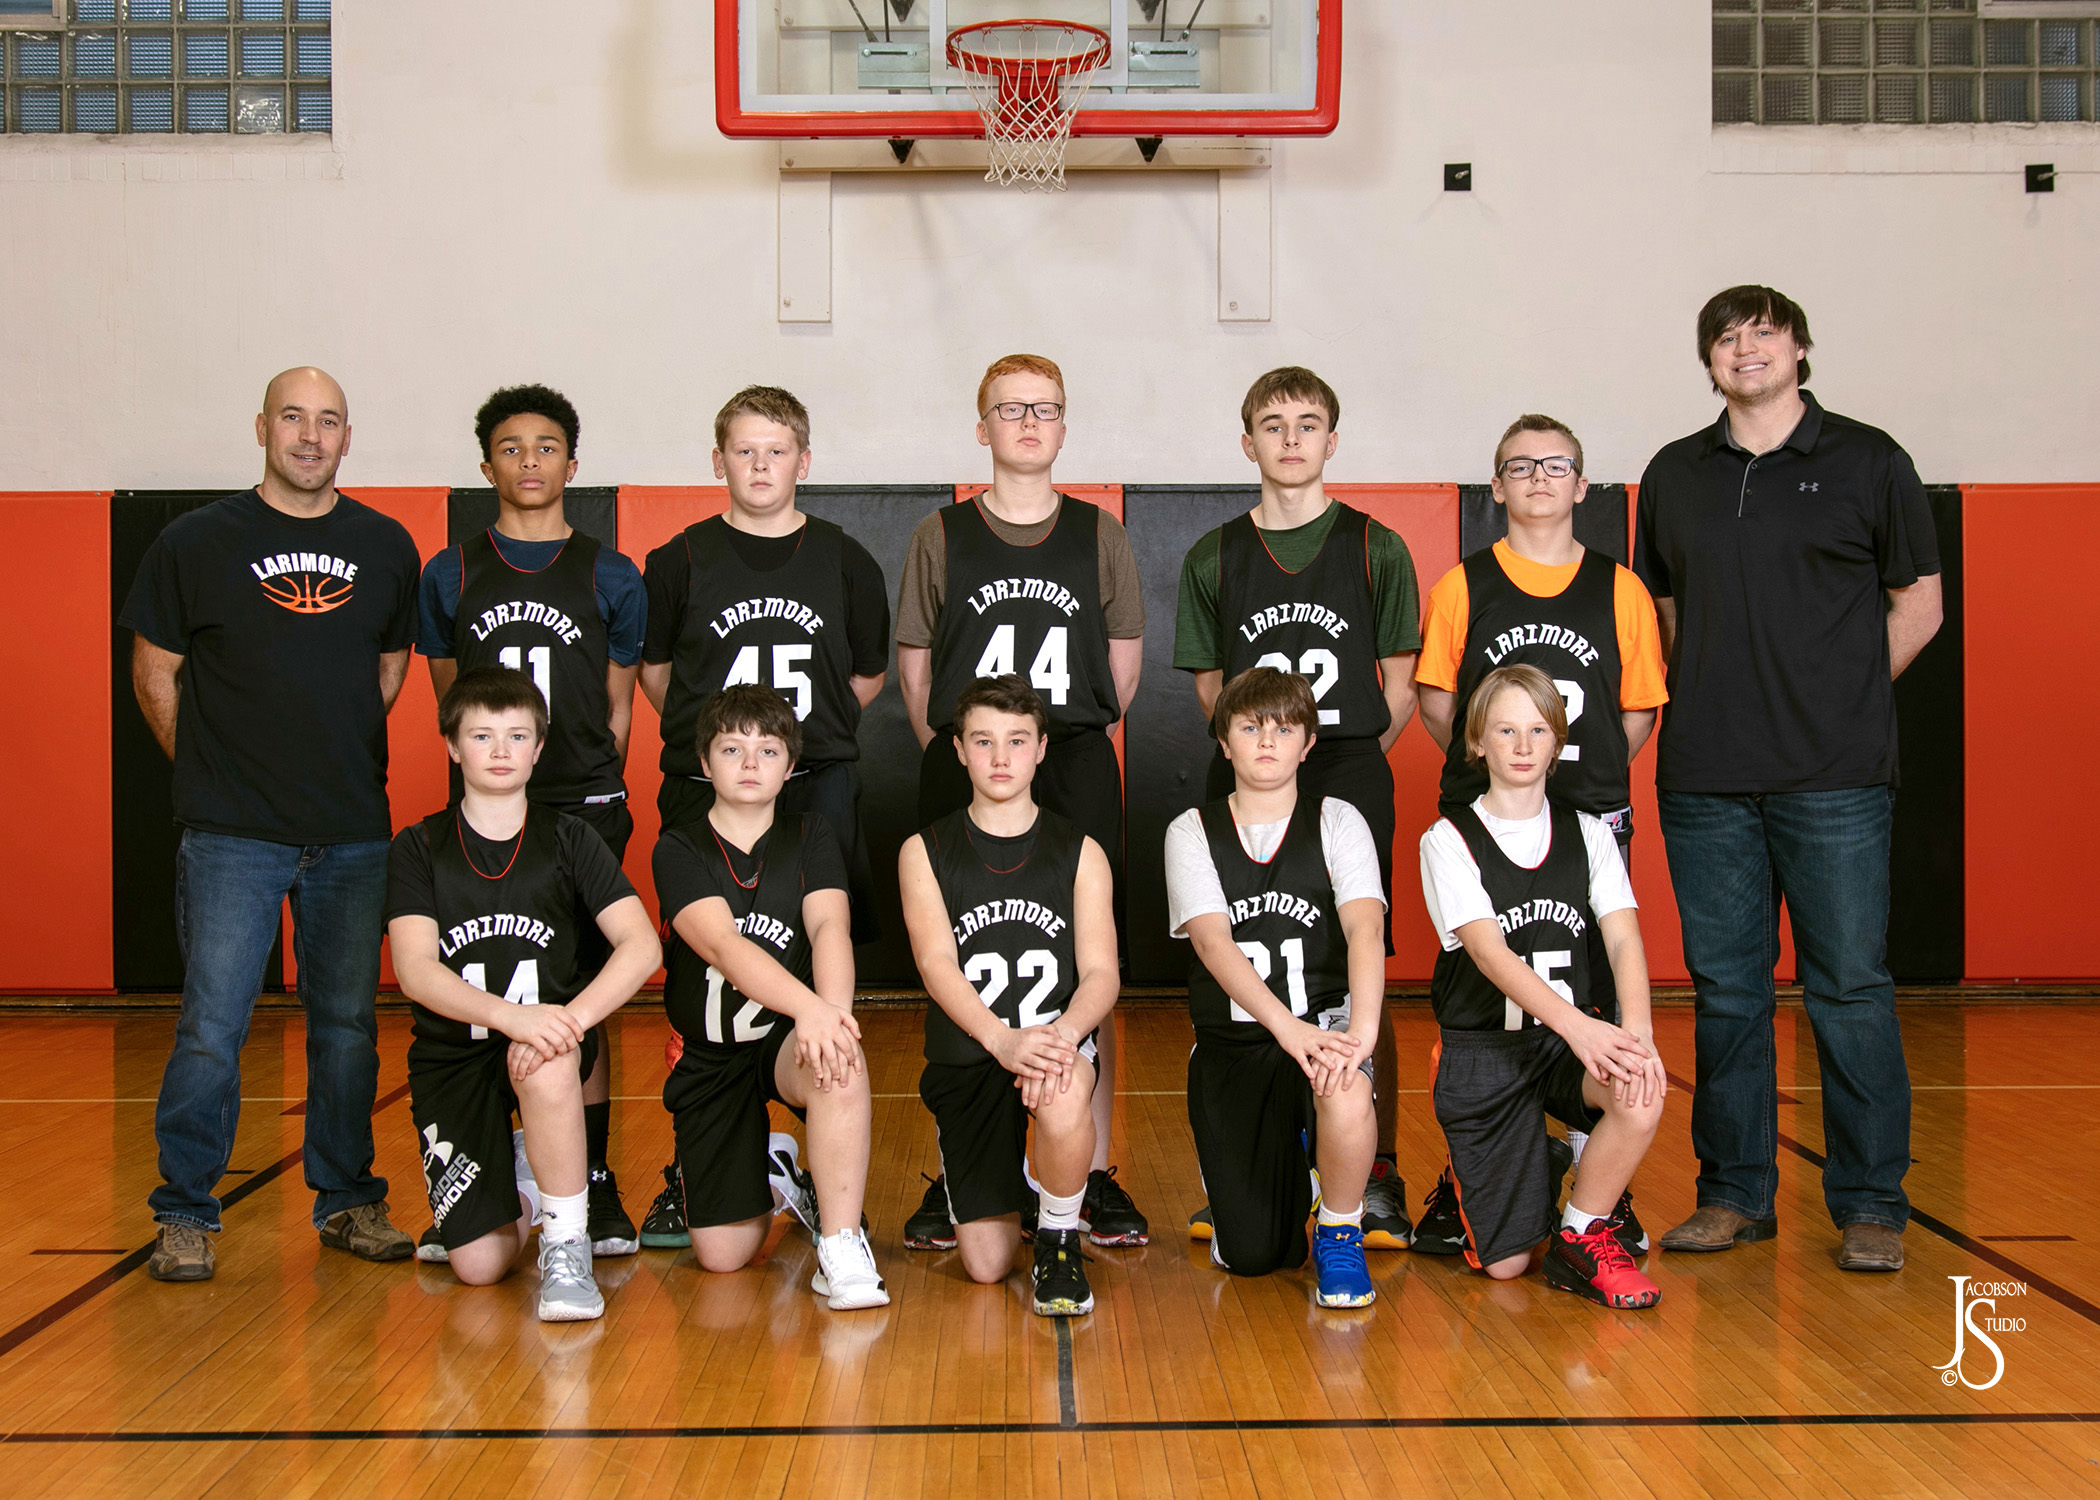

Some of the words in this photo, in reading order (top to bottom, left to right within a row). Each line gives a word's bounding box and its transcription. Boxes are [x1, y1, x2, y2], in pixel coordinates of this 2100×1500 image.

[250, 552, 359, 583] LARIMORE
[709, 597, 824, 639] LARIMORE
[967, 577, 1081, 618] LARIMORE
[470, 600, 582, 646] LARIMORE
[1239, 602, 1349, 643] LARIMORE
[1484, 623, 1600, 668] LARIMORE
[722, 643, 813, 722] 45
[974, 624, 1071, 706] 44
[1253, 647, 1341, 726] 2
[438, 913, 555, 959] LARIMORE
[953, 898, 1066, 947] LARIMORE
[1495, 898, 1587, 940] ARIMORE
[963, 948, 1062, 1030] 22
